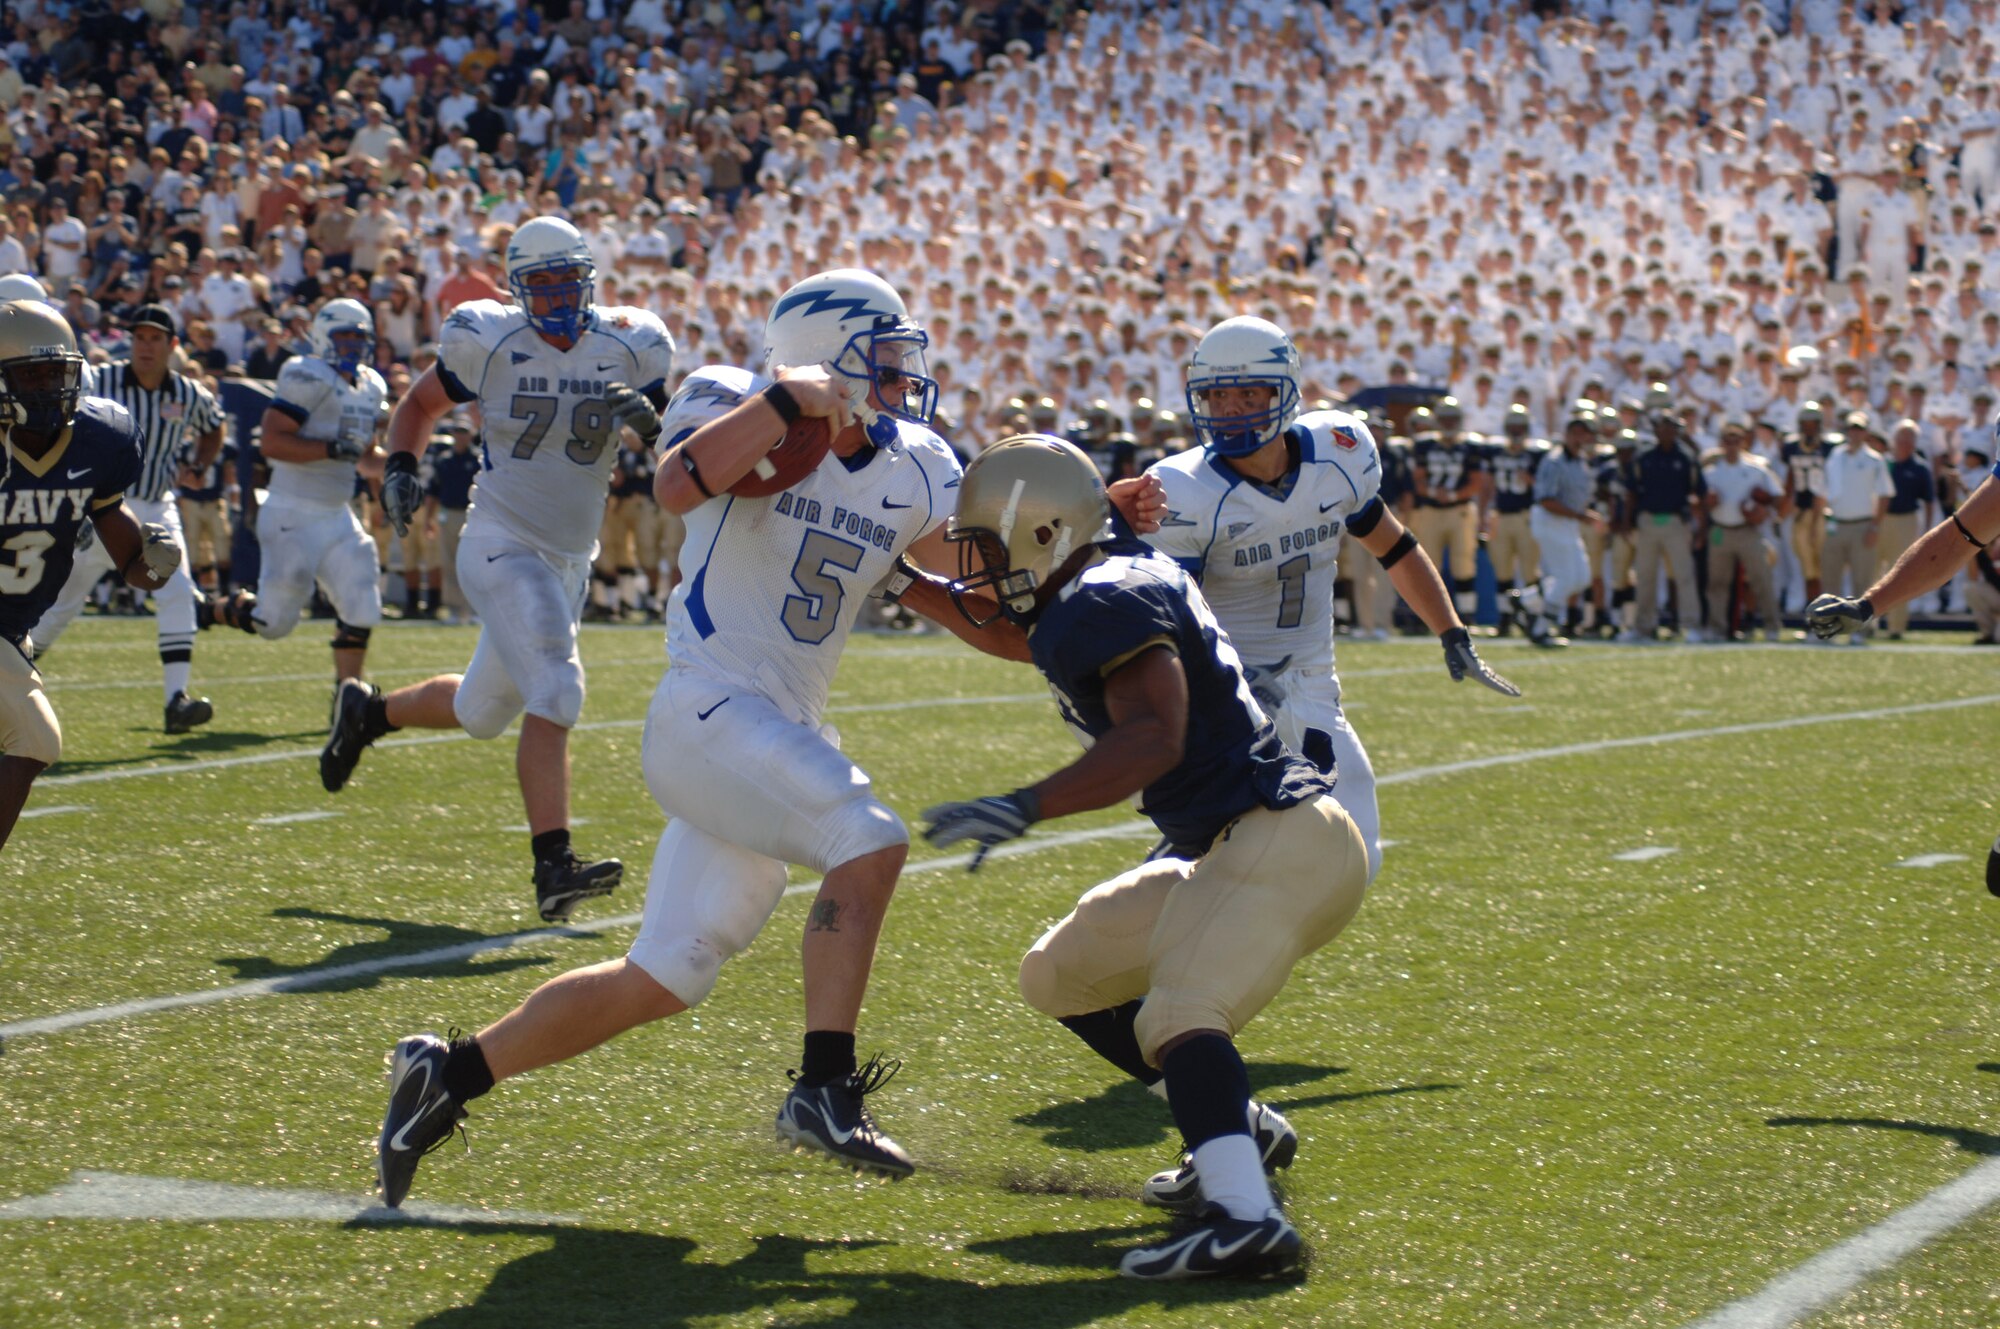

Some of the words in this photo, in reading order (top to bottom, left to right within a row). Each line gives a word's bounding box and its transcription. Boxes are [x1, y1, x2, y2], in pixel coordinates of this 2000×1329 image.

[518, 376, 549, 393] AIR
[509, 394, 616, 465] 79
[0, 487, 94, 526] AVY
[774, 491, 822, 525] AIR
[831, 506, 898, 552] FORCE
[1234, 543, 1273, 567] AIR
[1279, 521, 1340, 555] FORCE
[780, 527, 866, 646] 5
[1276, 553, 1311, 629] 1
